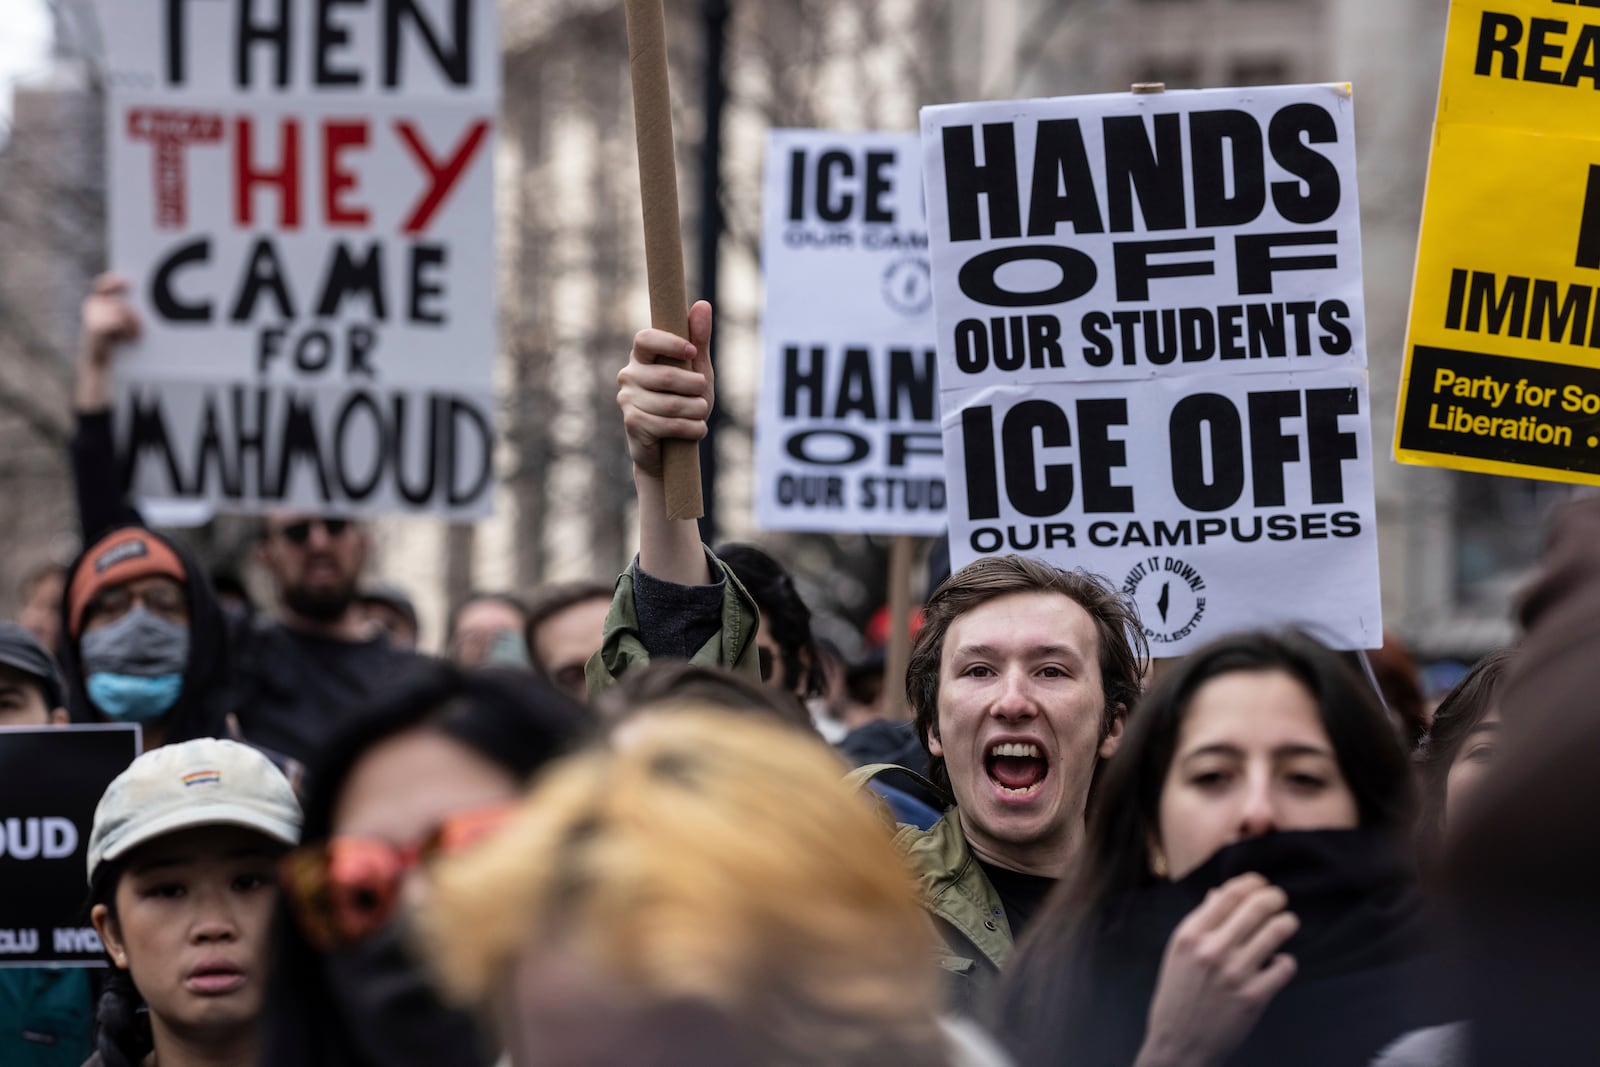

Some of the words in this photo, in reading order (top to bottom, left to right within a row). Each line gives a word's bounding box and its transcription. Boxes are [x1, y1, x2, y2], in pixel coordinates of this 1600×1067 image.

[1474, 11, 1600, 91] REA
[127, 108, 490, 234] THEY
[789, 149, 895, 222] ICE
[942, 103, 1341, 241] HANDS
[785, 230, 854, 248] OUR
[958, 230, 1338, 307] OFF
[150, 237, 446, 324] CAME
[256, 327, 377, 379] FOR
[954, 315, 1066, 374] OUR
[1081, 299, 1353, 367] STUDENTS
[783, 347, 936, 420] HAN
[1433, 367, 1511, 408] Party
[1515, 379, 1557, 408] for
[1561, 385, 1600, 415] So
[122, 384, 493, 506] MAHMOUD
[785, 429, 944, 467] OF
[962, 398, 1135, 521] ICE
[1169, 387, 1359, 512] OFF
[1428, 403, 1573, 447] Liberation
[777, 474, 844, 507] OUR
[860, 476, 947, 512] STUD
[969, 523, 1077, 553] OUR
[1088, 511, 1362, 548] CAMPUSES
[1122, 562, 1147, 595] SHUT
[1147, 556, 1160, 572] IT
[1164, 556, 1206, 593] DOWN!
[1144, 597, 1206, 643] PALESTINE
[0, 816, 79, 860] UD
